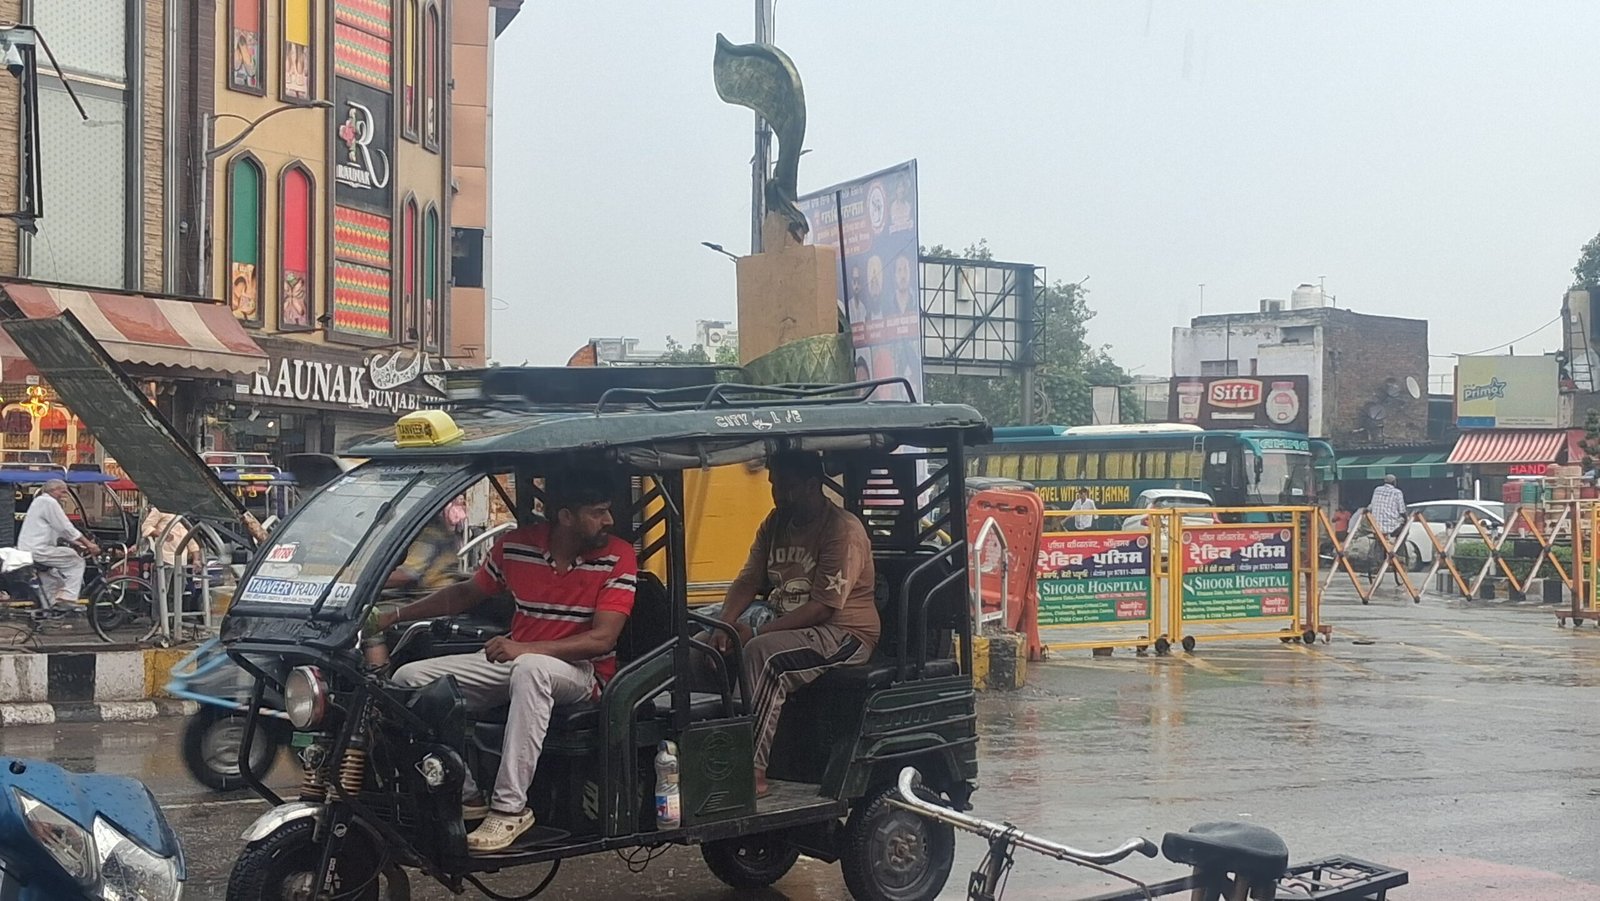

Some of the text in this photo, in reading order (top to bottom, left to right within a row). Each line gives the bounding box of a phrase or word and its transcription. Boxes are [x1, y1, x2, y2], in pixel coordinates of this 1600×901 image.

[336, 164, 371, 186] RAUNAK
[252, 357, 367, 404] RAUNAK
[368, 388, 421, 412] PUNJABI
[1213, 385, 1255, 400] Sifti
[1510, 464, 1547, 474] HAND
[1034, 486, 1060, 502] RAVEL
[249, 579, 292, 596] TANVEER
[334, 585, 350, 599] CO.
[1042, 580, 1147, 596] SHOOR HOSPITAL
[1195, 575, 1289, 590] SHOOR HOSPITAL
